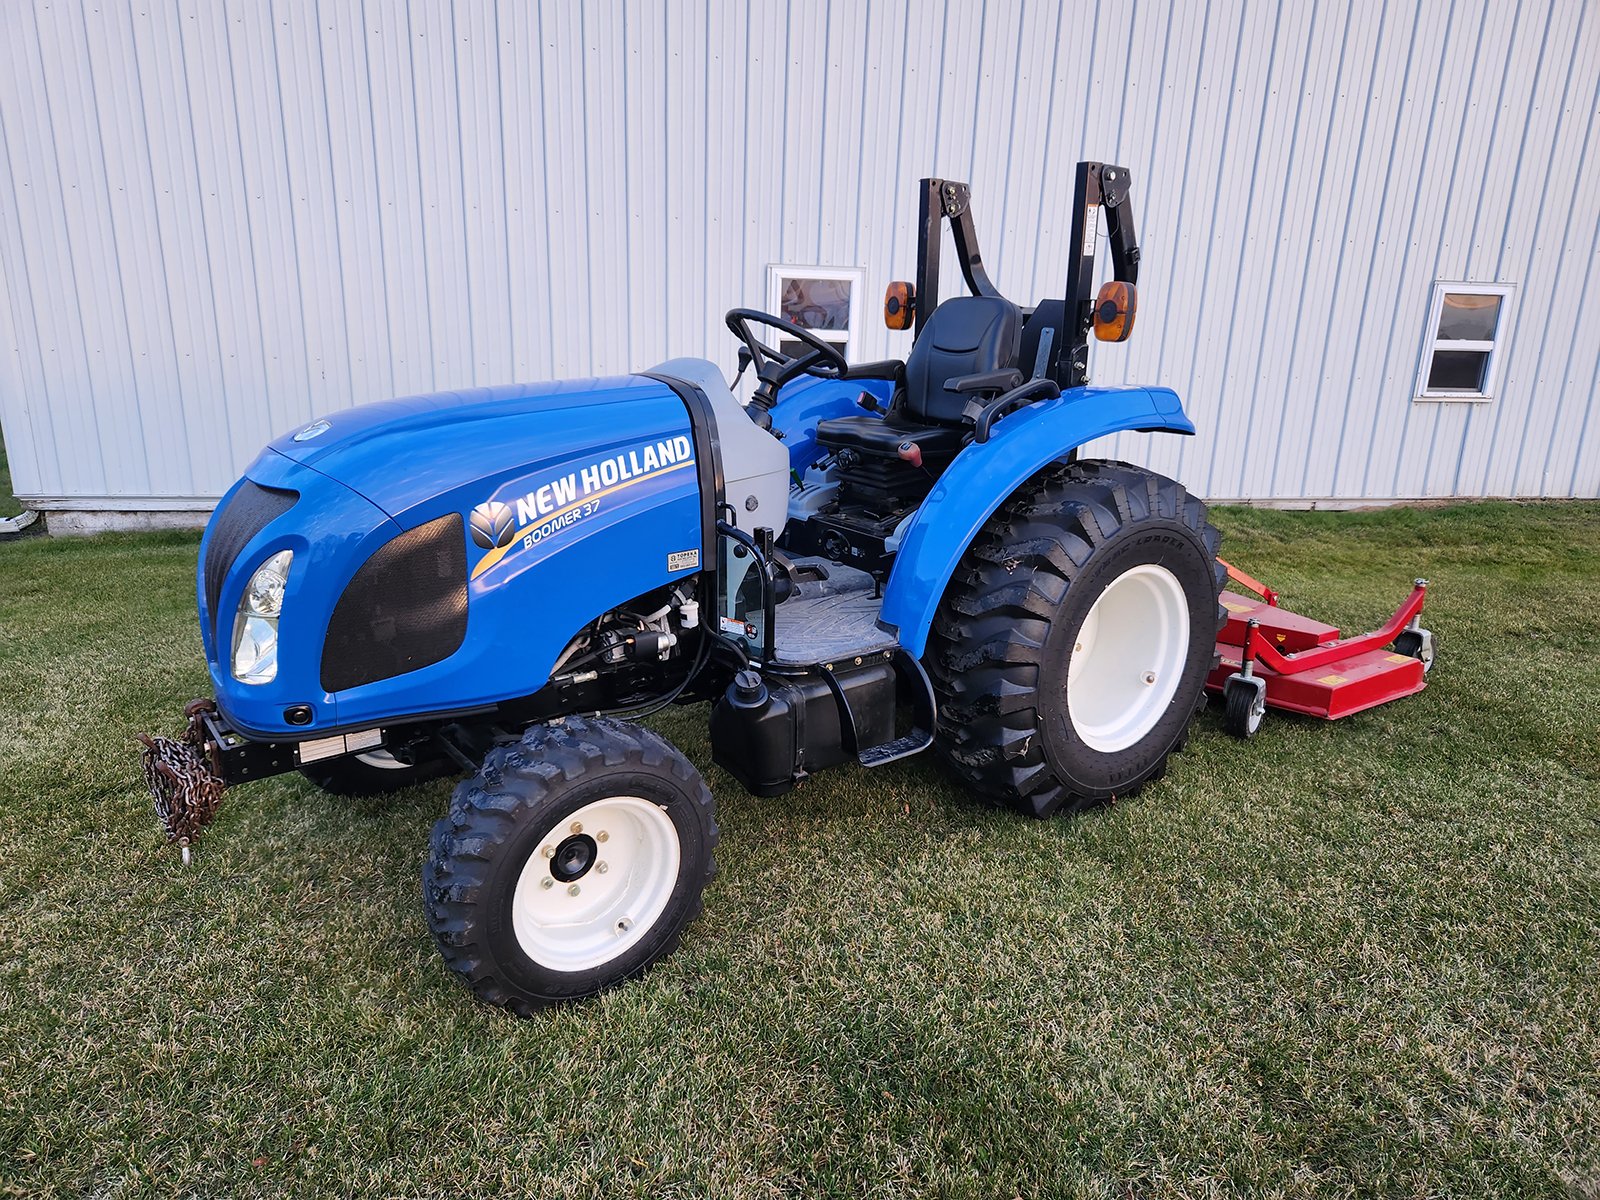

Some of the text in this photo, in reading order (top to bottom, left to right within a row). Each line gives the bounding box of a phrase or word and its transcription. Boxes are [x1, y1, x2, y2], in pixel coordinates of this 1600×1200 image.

[516, 435, 691, 526] NEW HOLLAND
[523, 499, 601, 550] BOOMER 37
